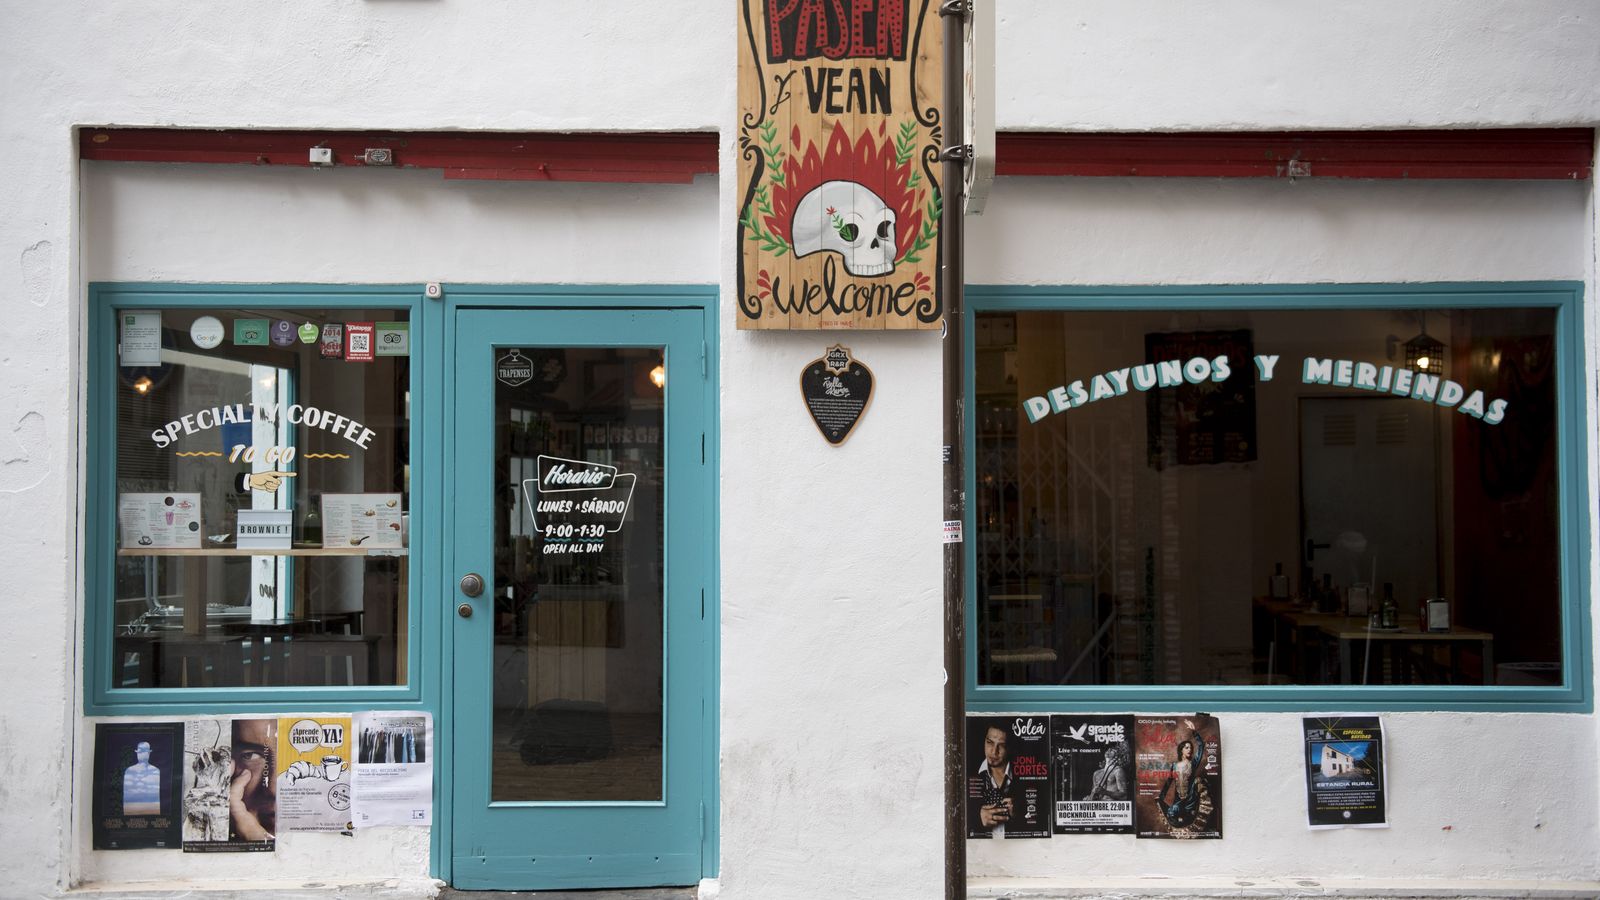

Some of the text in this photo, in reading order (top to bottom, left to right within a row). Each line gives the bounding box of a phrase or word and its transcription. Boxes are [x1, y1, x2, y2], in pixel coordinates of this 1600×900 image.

[763, 0, 909, 63] PASEN
[803, 66, 893, 116] VEAN
[499, 368, 531, 378] TRAPENSES
[1023, 355, 1508, 425] DESAYUNOS Y MERIENDAS
[151, 403, 376, 450] SPECIALTY COFFEE
[229, 444, 296, 464] TO GO
[544, 464, 611, 485] Horario
[537, 500, 573, 513] LUNES
[581, 497, 625, 513] SÁBADO
[240, 525, 281, 534] BROWNIE
[543, 543, 604, 554] OPEN ALL DAY
[1014, 718, 1047, 736] Soleá
[1088, 722, 1125, 736] grande
[323, 728, 343, 743] YA!
[1094, 733, 1125, 744] royale
[1013, 756, 1036, 764] JONI
[1013, 761, 1048, 775] CORTÉS
[1057, 802, 1130, 811] LUNES 11 NOVIEMBRE 22:00 H
[1058, 811, 1096, 819] ROCKNROLLA
